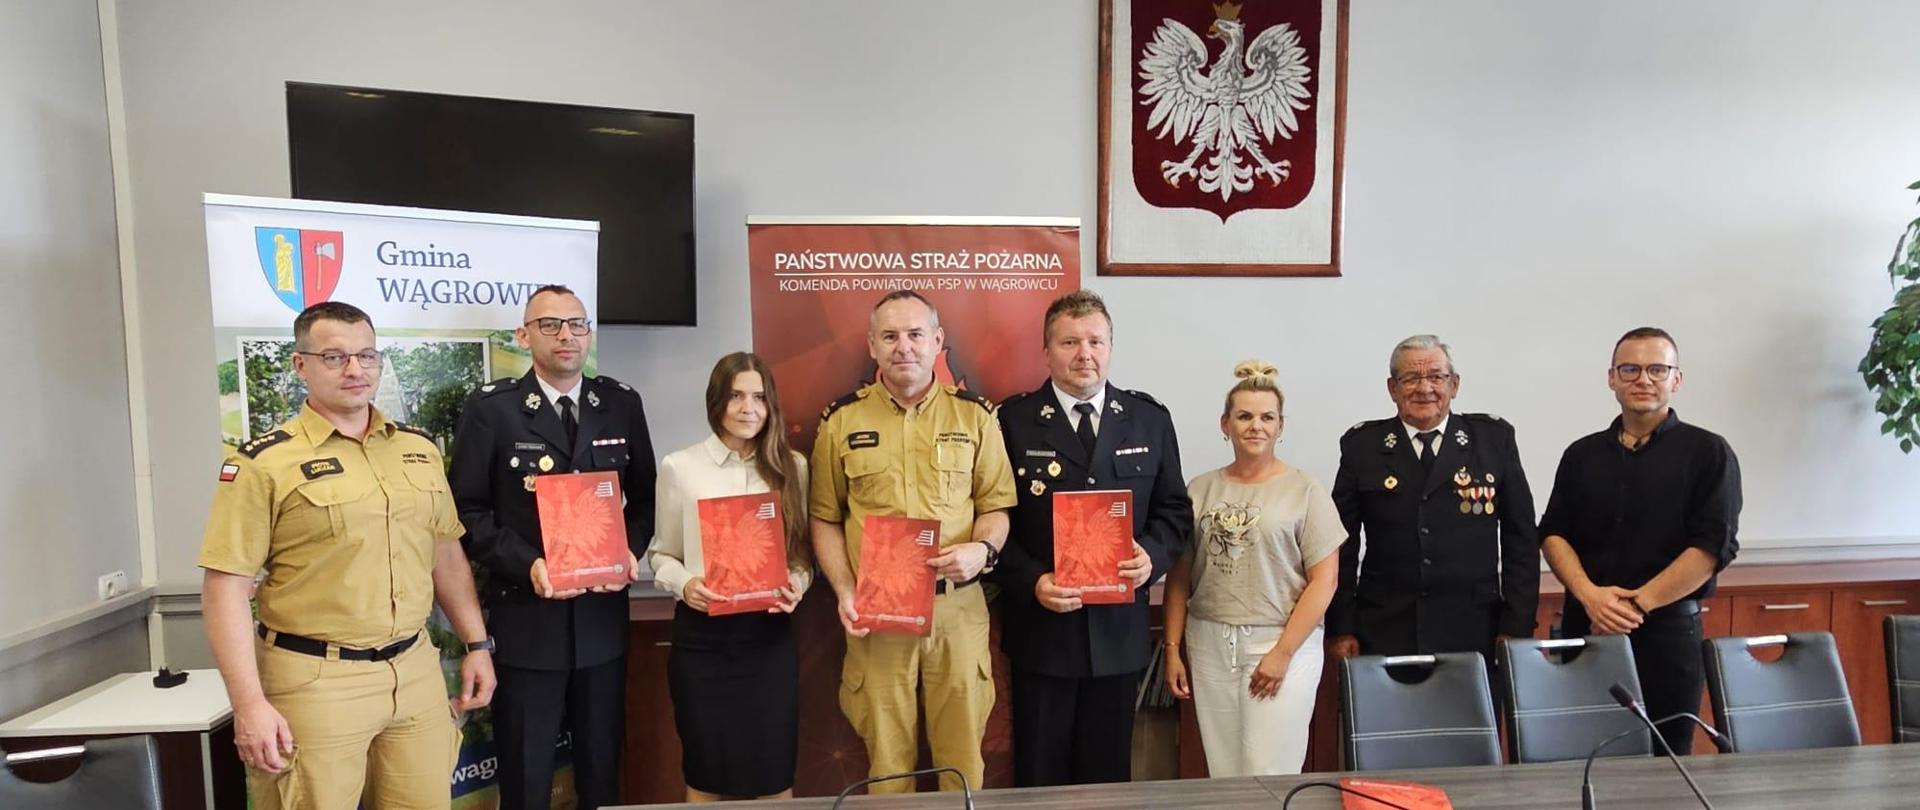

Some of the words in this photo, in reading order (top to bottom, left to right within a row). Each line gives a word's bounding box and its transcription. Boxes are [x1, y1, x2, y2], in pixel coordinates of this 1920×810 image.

[376, 240, 472, 270] Gmina
[774, 249, 906, 270] PAŃSTWOWA
[910, 249, 970, 270] STRAŻ
[975, 249, 1063, 270] POŻARNA
[376, 277, 567, 310] WĄGROWI
[779, 278, 850, 292] KOMENDA
[852, 278, 935, 291] POWIATOWA
[937, 278, 961, 291] PSP
[963, 279, 976, 290] W
[979, 278, 1058, 293] WĄGROWCU
